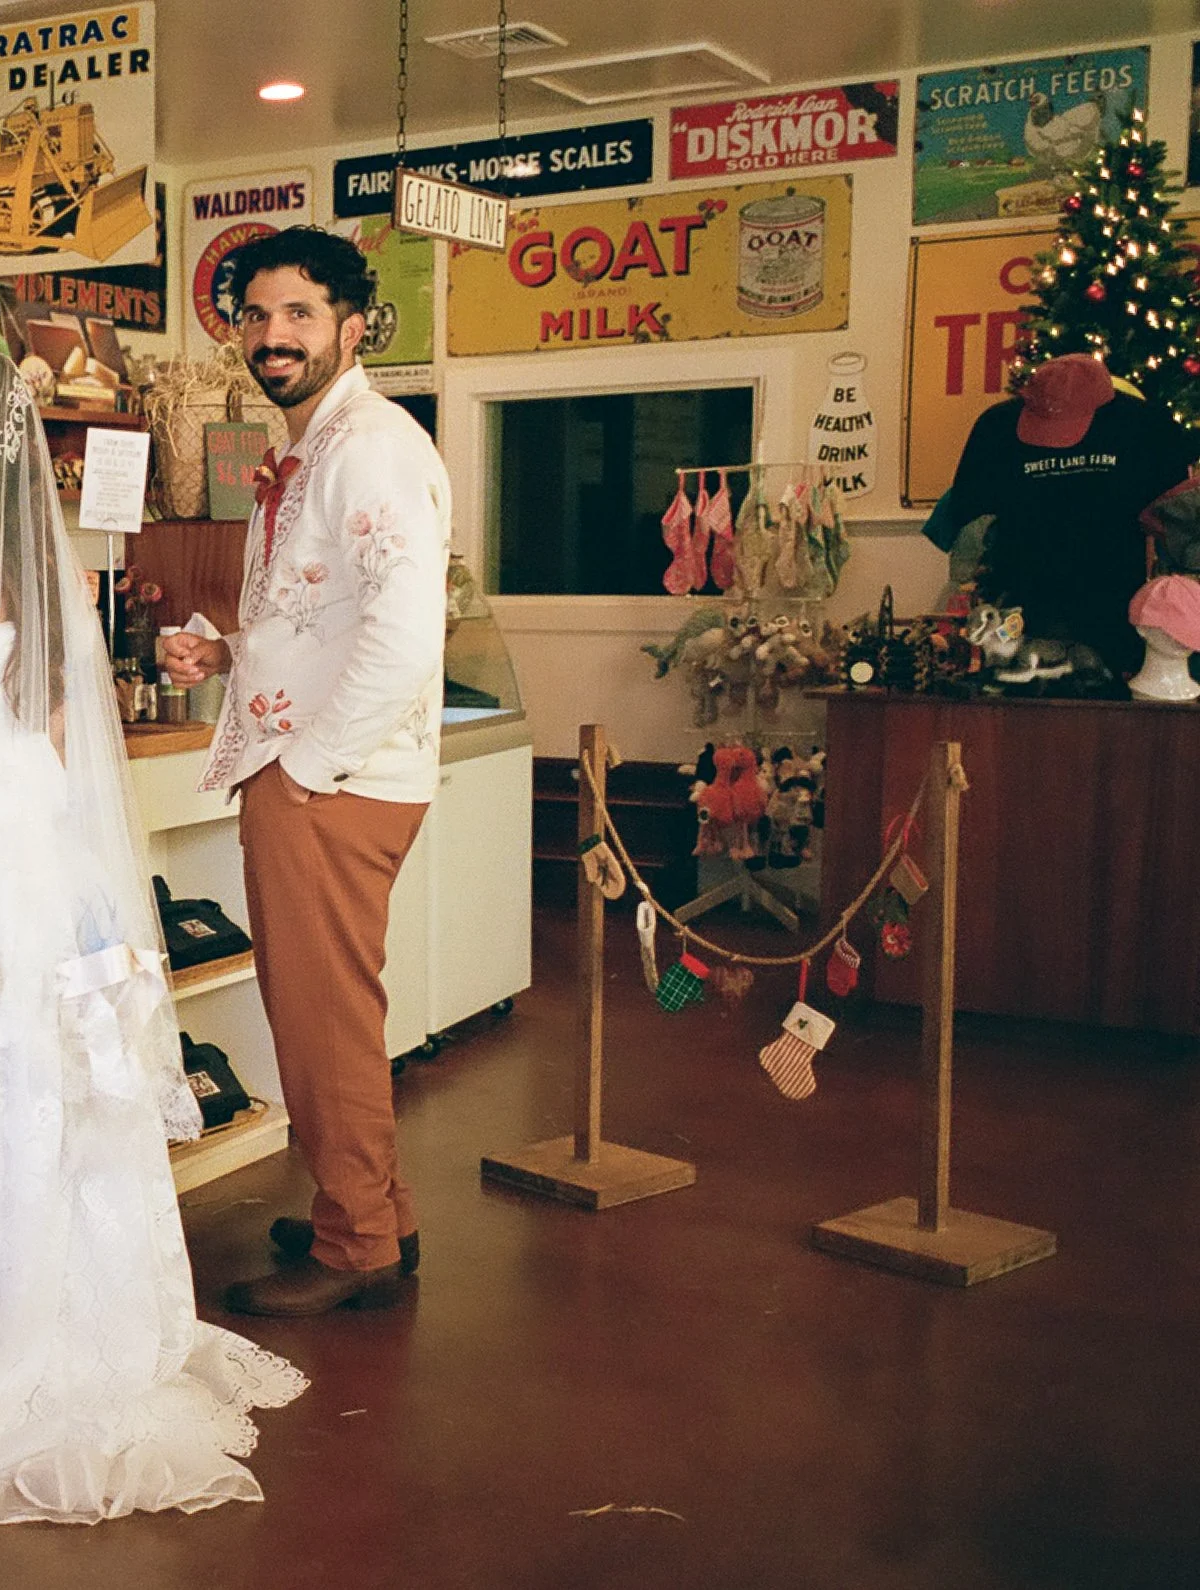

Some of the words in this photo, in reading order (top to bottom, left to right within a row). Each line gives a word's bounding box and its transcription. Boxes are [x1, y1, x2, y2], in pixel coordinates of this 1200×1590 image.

[8, 48, 150, 92] DEALER
[930, 77, 1036, 110] SCRATCH
[1051, 65, 1133, 96] FEEDS
[550, 140, 632, 172] SCALES
[726, 154, 779, 172] SOLD
[784, 148, 838, 166] HERE
[193, 182, 306, 220] WALDRON'S
[405, 180, 460, 234] GELATO
[470, 196, 504, 245] LINE
[508, 214, 708, 287] GOAT
[540, 302, 666, 343] MILK
[833, 387, 857, 403] BE
[814, 411, 873, 432] HEALTHY
[818, 443, 868, 462] DRINK
[1024, 459, 1056, 473] SWEET
[1060, 456, 1086, 469] LAND
[1090, 454, 1117, 466] FARM
